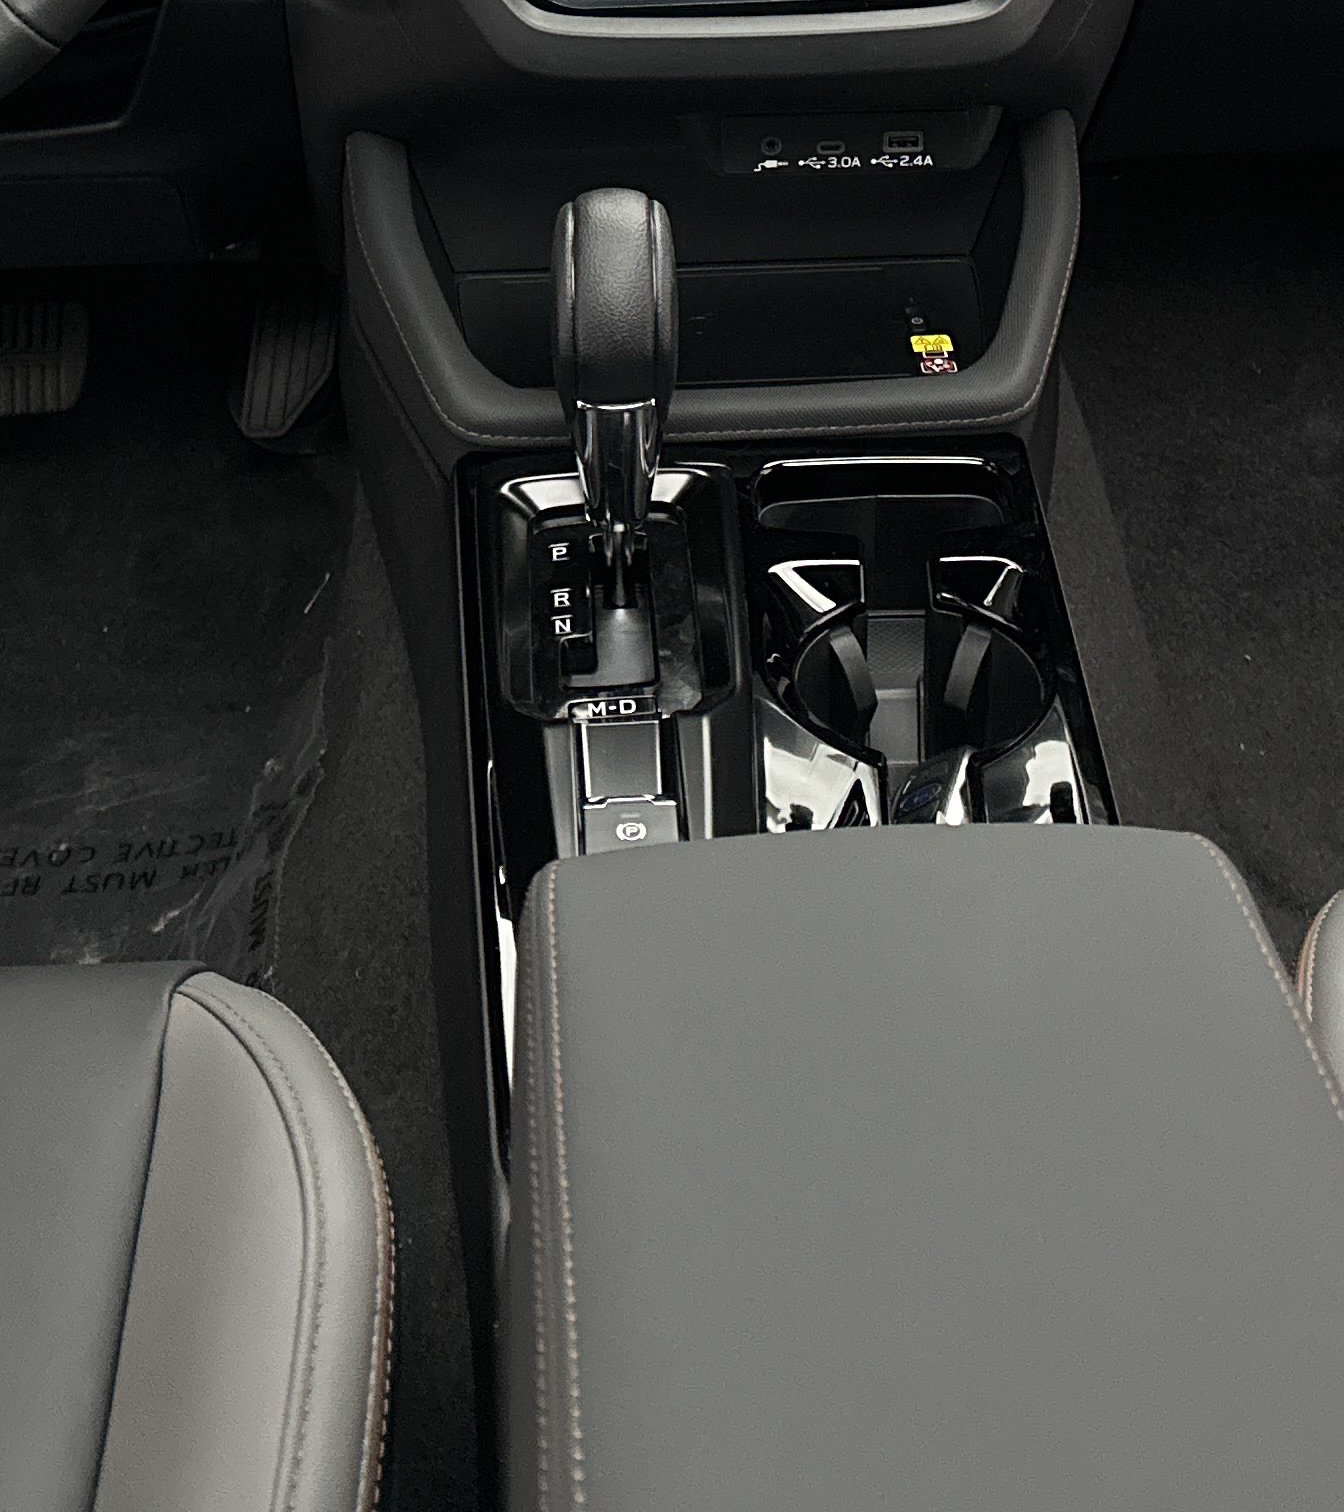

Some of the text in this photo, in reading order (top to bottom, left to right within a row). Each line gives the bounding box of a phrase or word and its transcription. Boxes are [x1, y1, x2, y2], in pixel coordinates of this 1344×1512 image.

[827, 156, 861, 168] 3.0A
[899, 155, 933, 167] 2.4A
[552, 546, 567, 561] P
[554, 592, 570, 607] R
[555, 618, 571, 634] N
[588, 698, 637, 718] M-D
[61, 869, 158, 894] MUST
